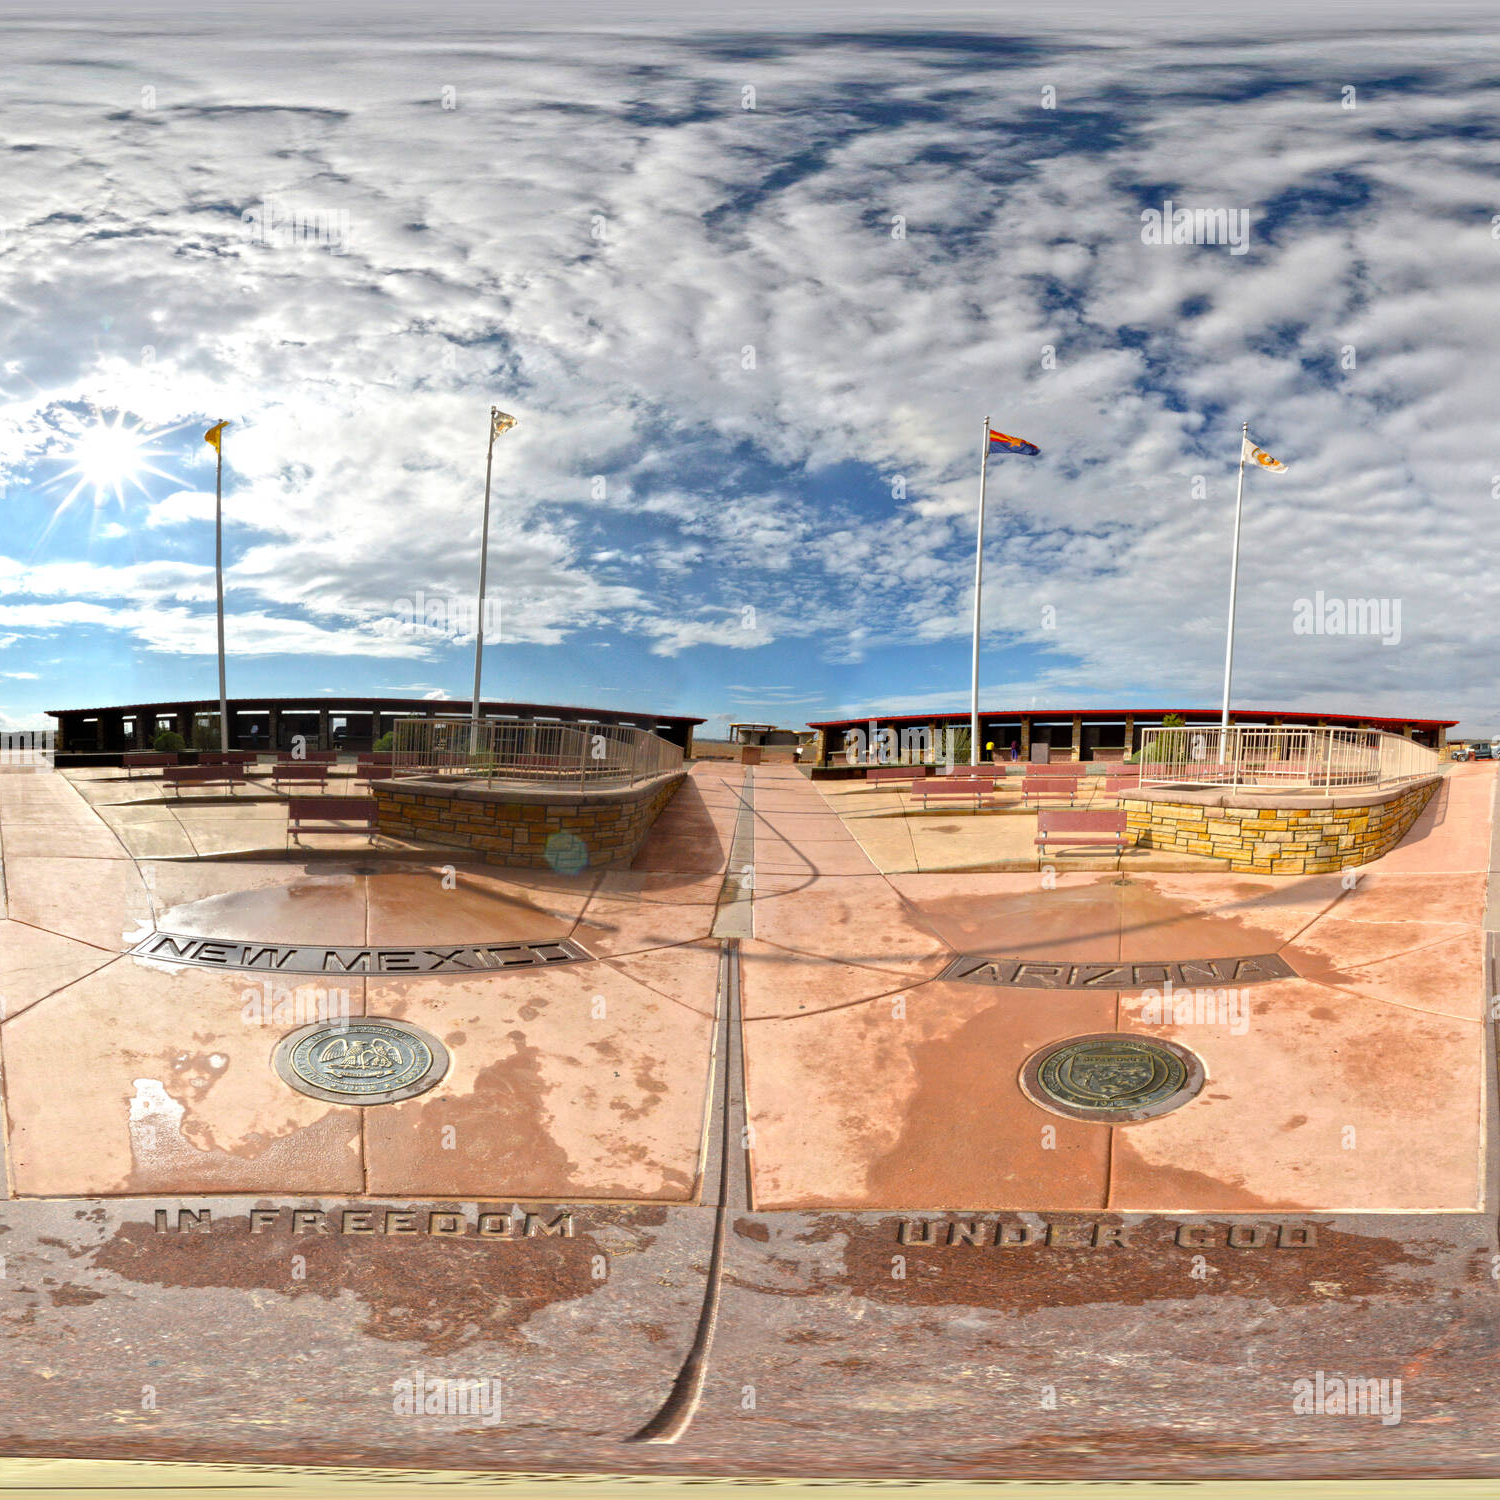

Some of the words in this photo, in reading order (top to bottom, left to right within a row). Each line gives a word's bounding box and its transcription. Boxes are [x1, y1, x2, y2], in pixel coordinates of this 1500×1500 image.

[150, 937, 297, 968] NEW
[322, 943, 579, 972] MEXICO
[957, 958, 1280, 985] ARIZONA
[154, 1208, 212, 1234] IN
[249, 1209, 576, 1238] FREEDOM
[898, 1221, 1130, 1248] UNDER
[1174, 1223, 1318, 1249] GOD
